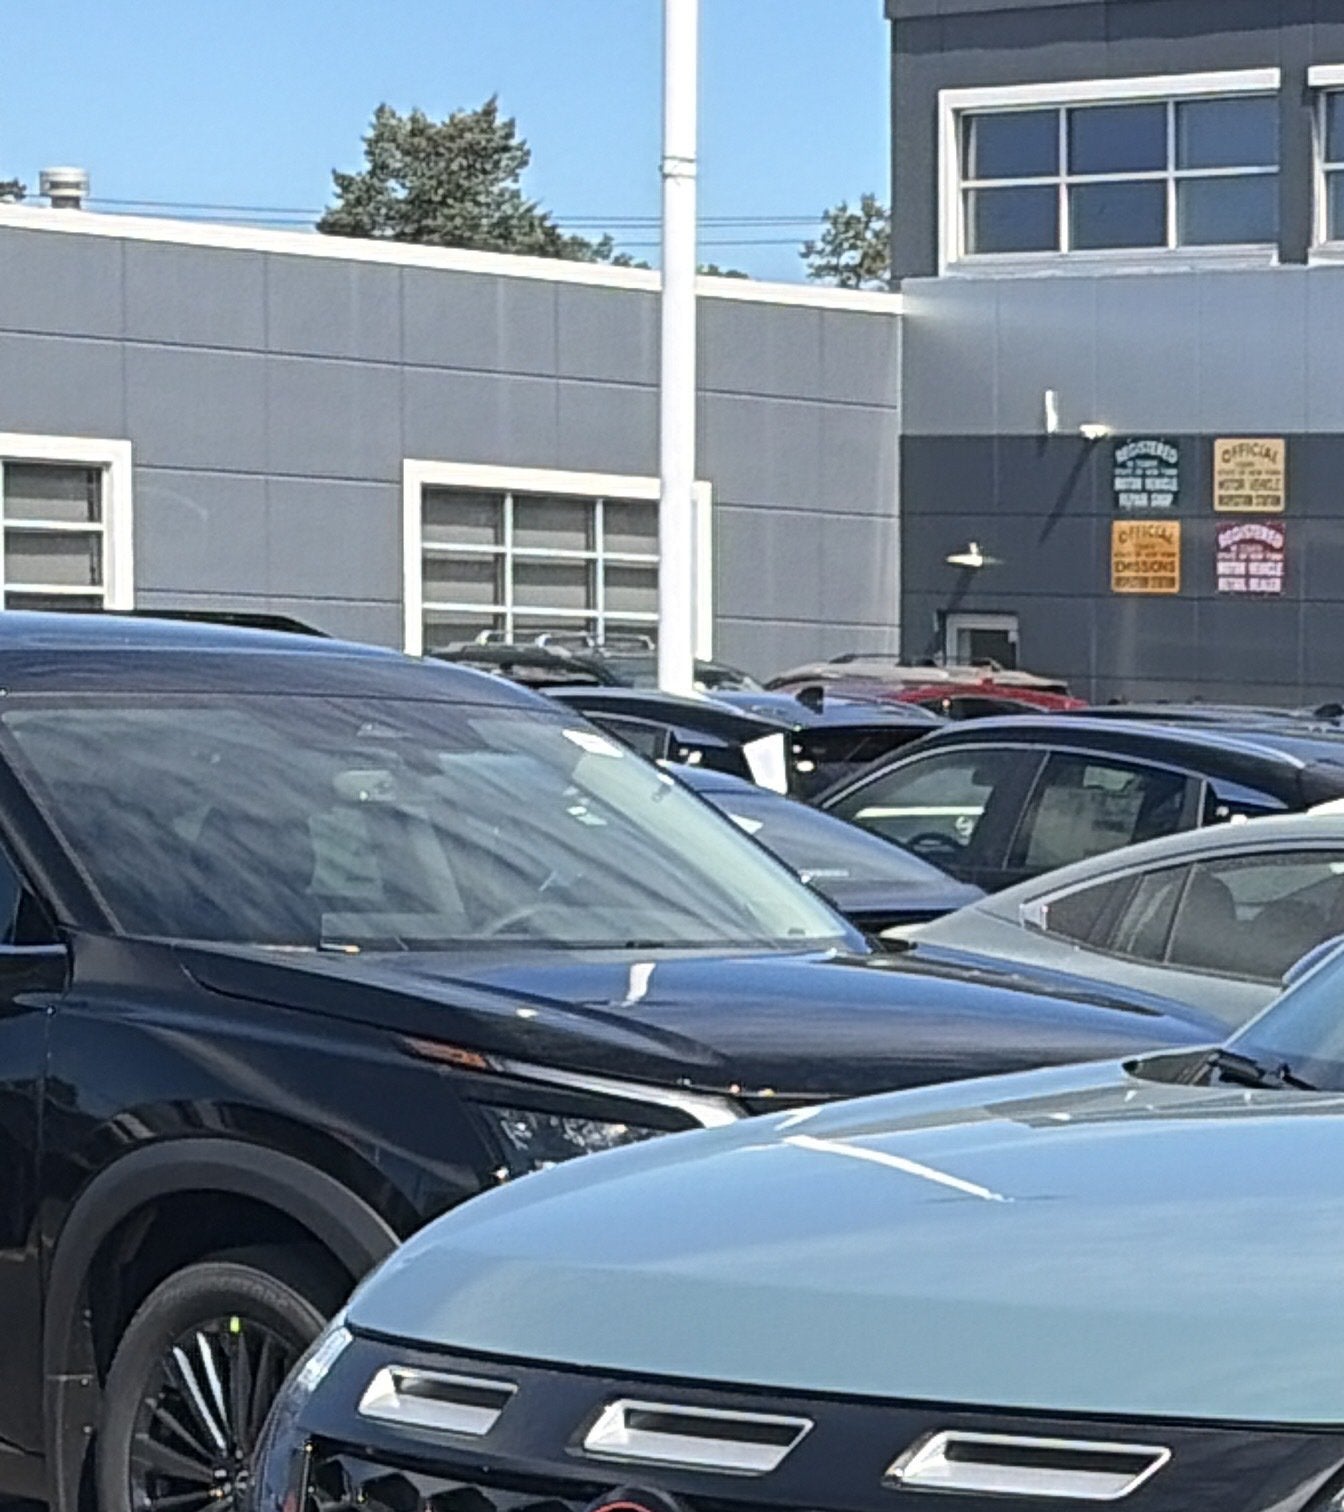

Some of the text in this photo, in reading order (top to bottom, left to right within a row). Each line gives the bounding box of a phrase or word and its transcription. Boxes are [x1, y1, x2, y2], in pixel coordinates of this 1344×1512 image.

[1114, 440, 1178, 464] REGISTERED
[1221, 442, 1279, 464] OFFICIAL
[1118, 524, 1174, 544] OFFICIAL
[1115, 560, 1175, 573] EMISSIONS
